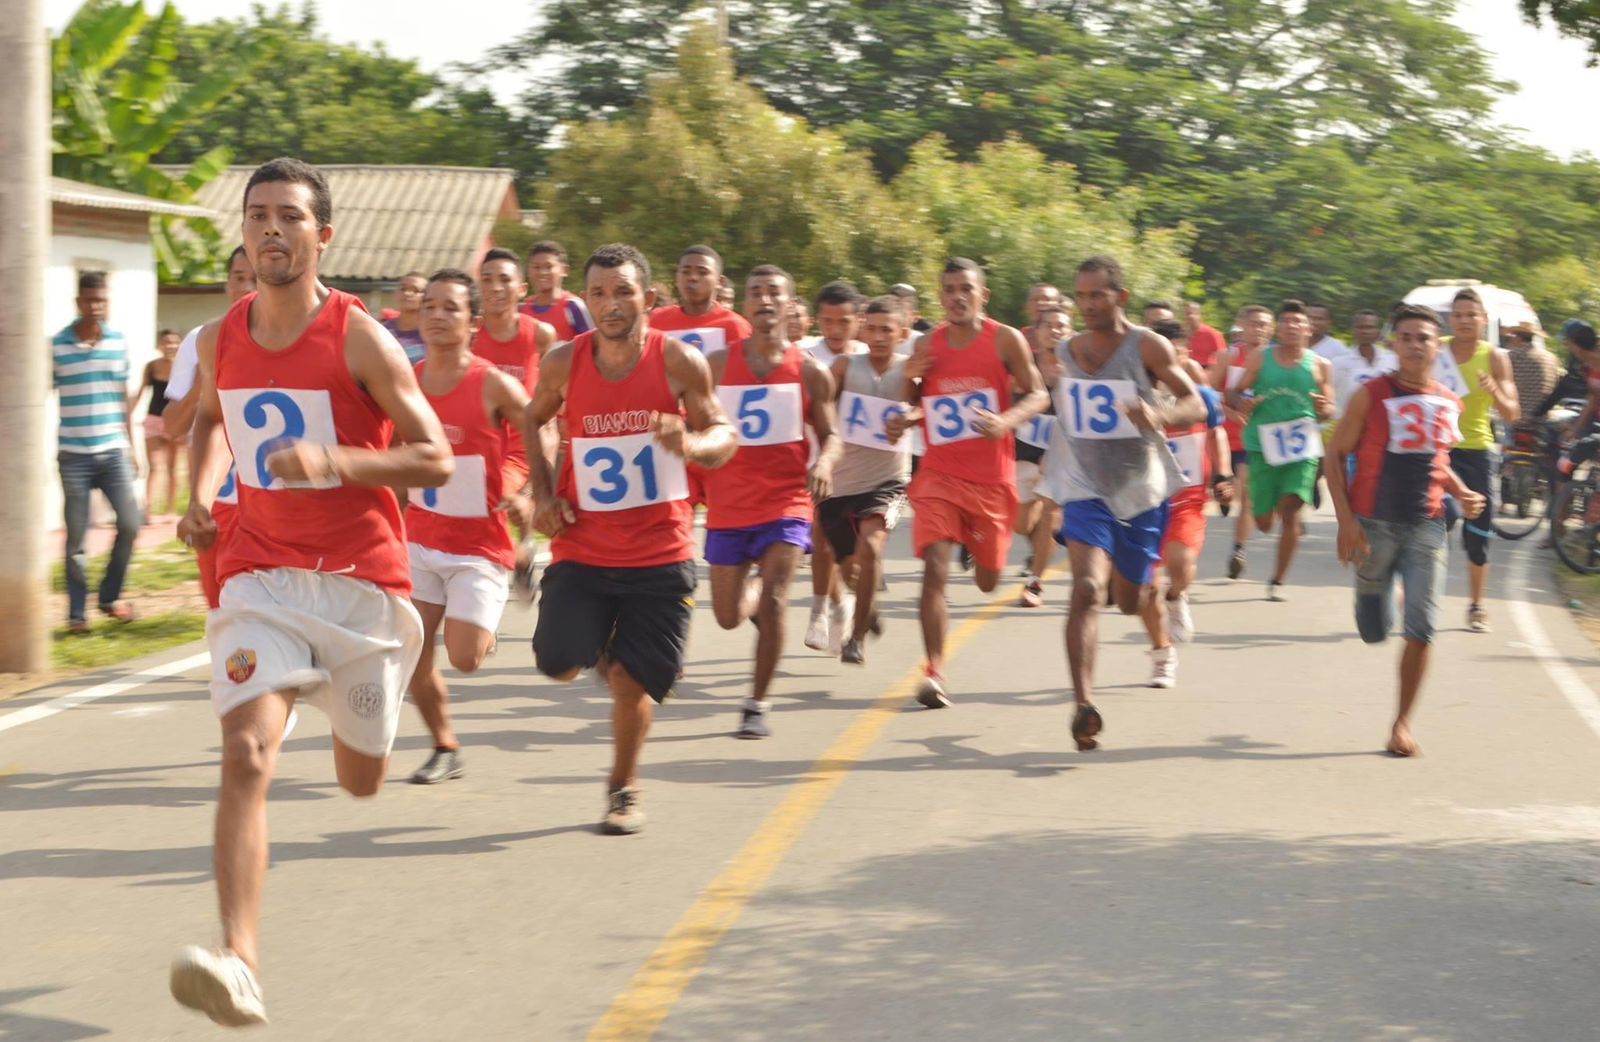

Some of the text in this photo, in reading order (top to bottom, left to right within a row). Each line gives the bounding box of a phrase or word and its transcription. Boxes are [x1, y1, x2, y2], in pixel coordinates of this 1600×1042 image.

[738, 387, 770, 439] 5
[1070, 383, 1119, 433] 13
[1273, 422, 1307, 457] 15
[584, 444, 658, 504] 31
